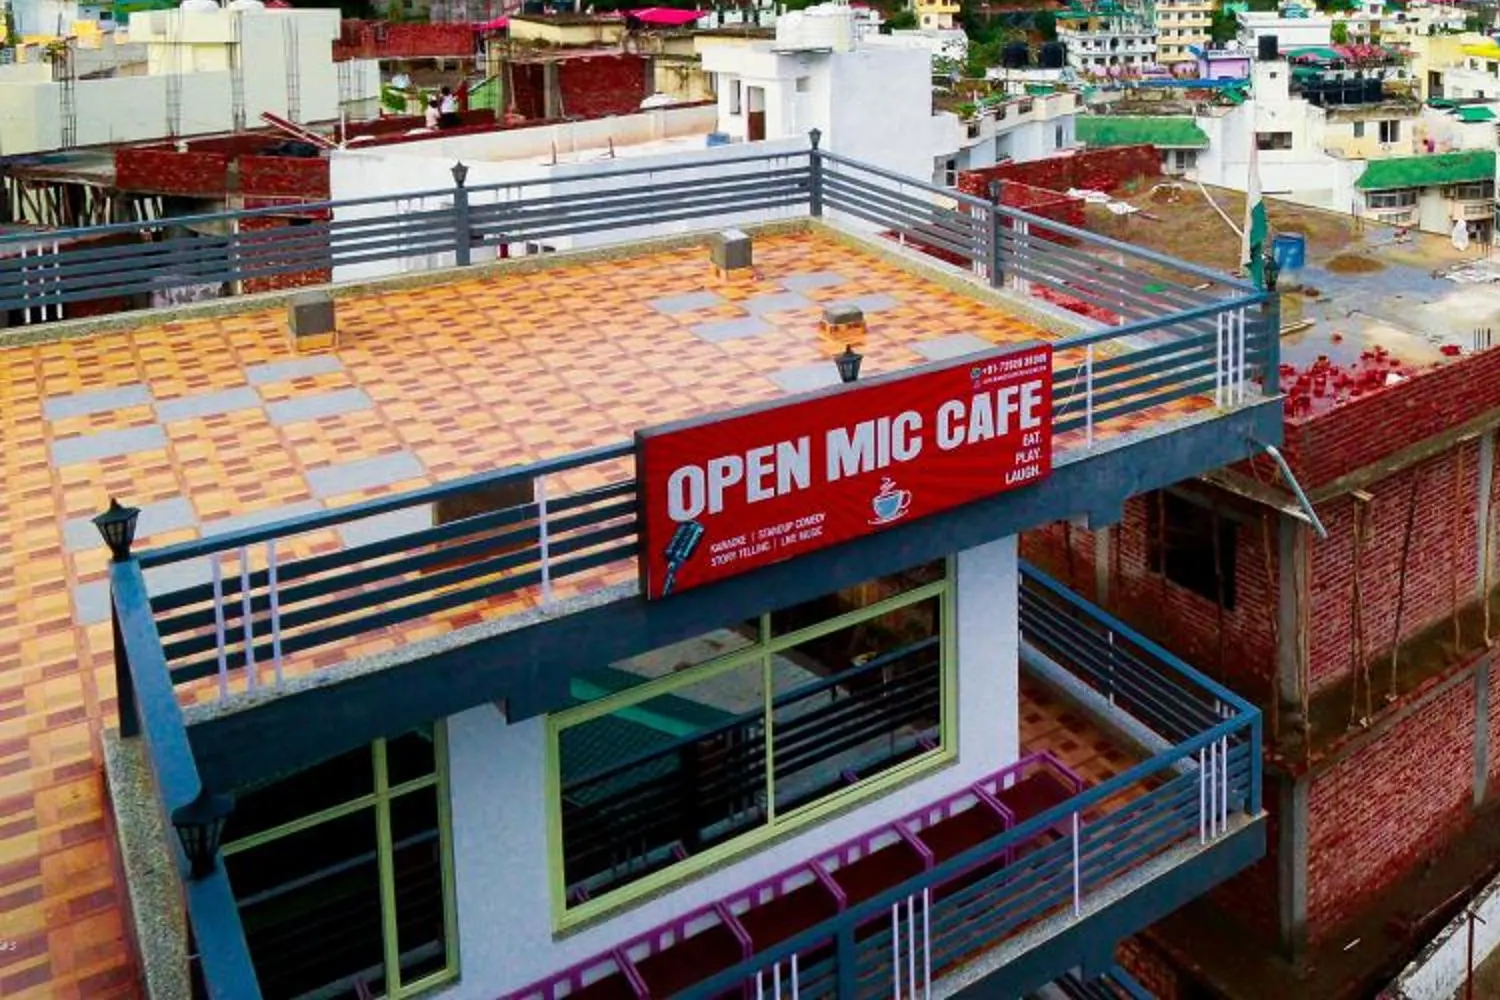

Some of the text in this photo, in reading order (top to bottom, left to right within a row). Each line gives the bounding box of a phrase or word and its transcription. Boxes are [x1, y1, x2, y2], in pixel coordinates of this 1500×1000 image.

[667, 379, 1042, 522] OPEN MIC CAFE
